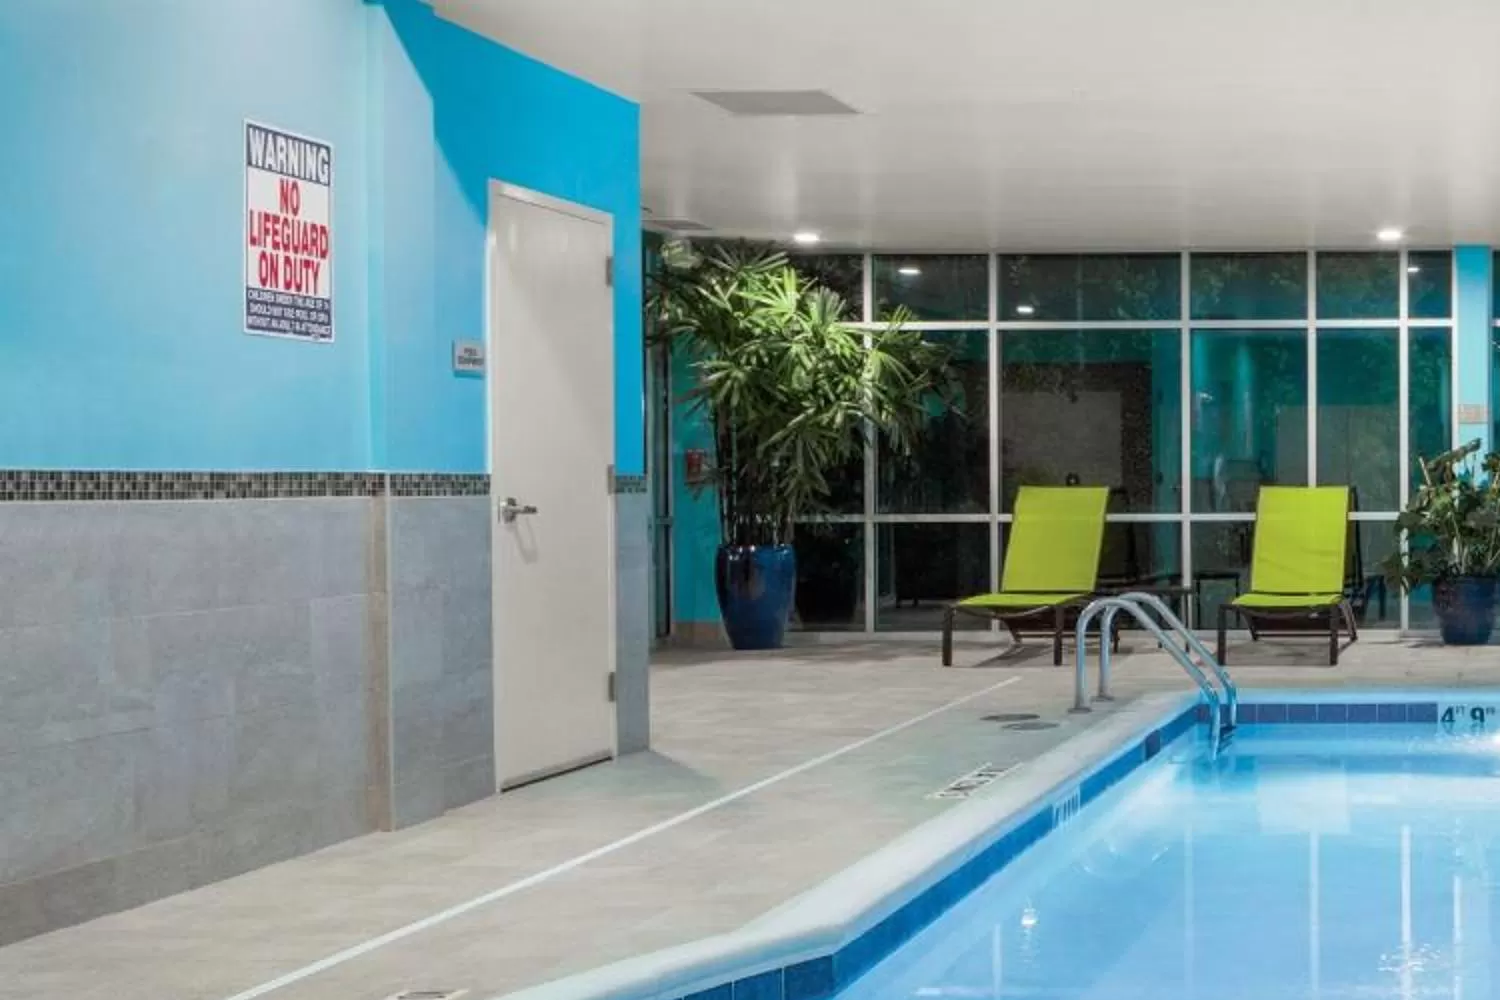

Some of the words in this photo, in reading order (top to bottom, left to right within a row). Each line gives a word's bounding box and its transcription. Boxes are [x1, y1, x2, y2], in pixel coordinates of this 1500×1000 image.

[249, 127, 329, 183] WARNING
[280, 178, 300, 217] NO
[249, 209, 328, 259] LIFEGUARD
[259, 251, 279, 290] ON
[284, 255, 321, 296] DUTY
